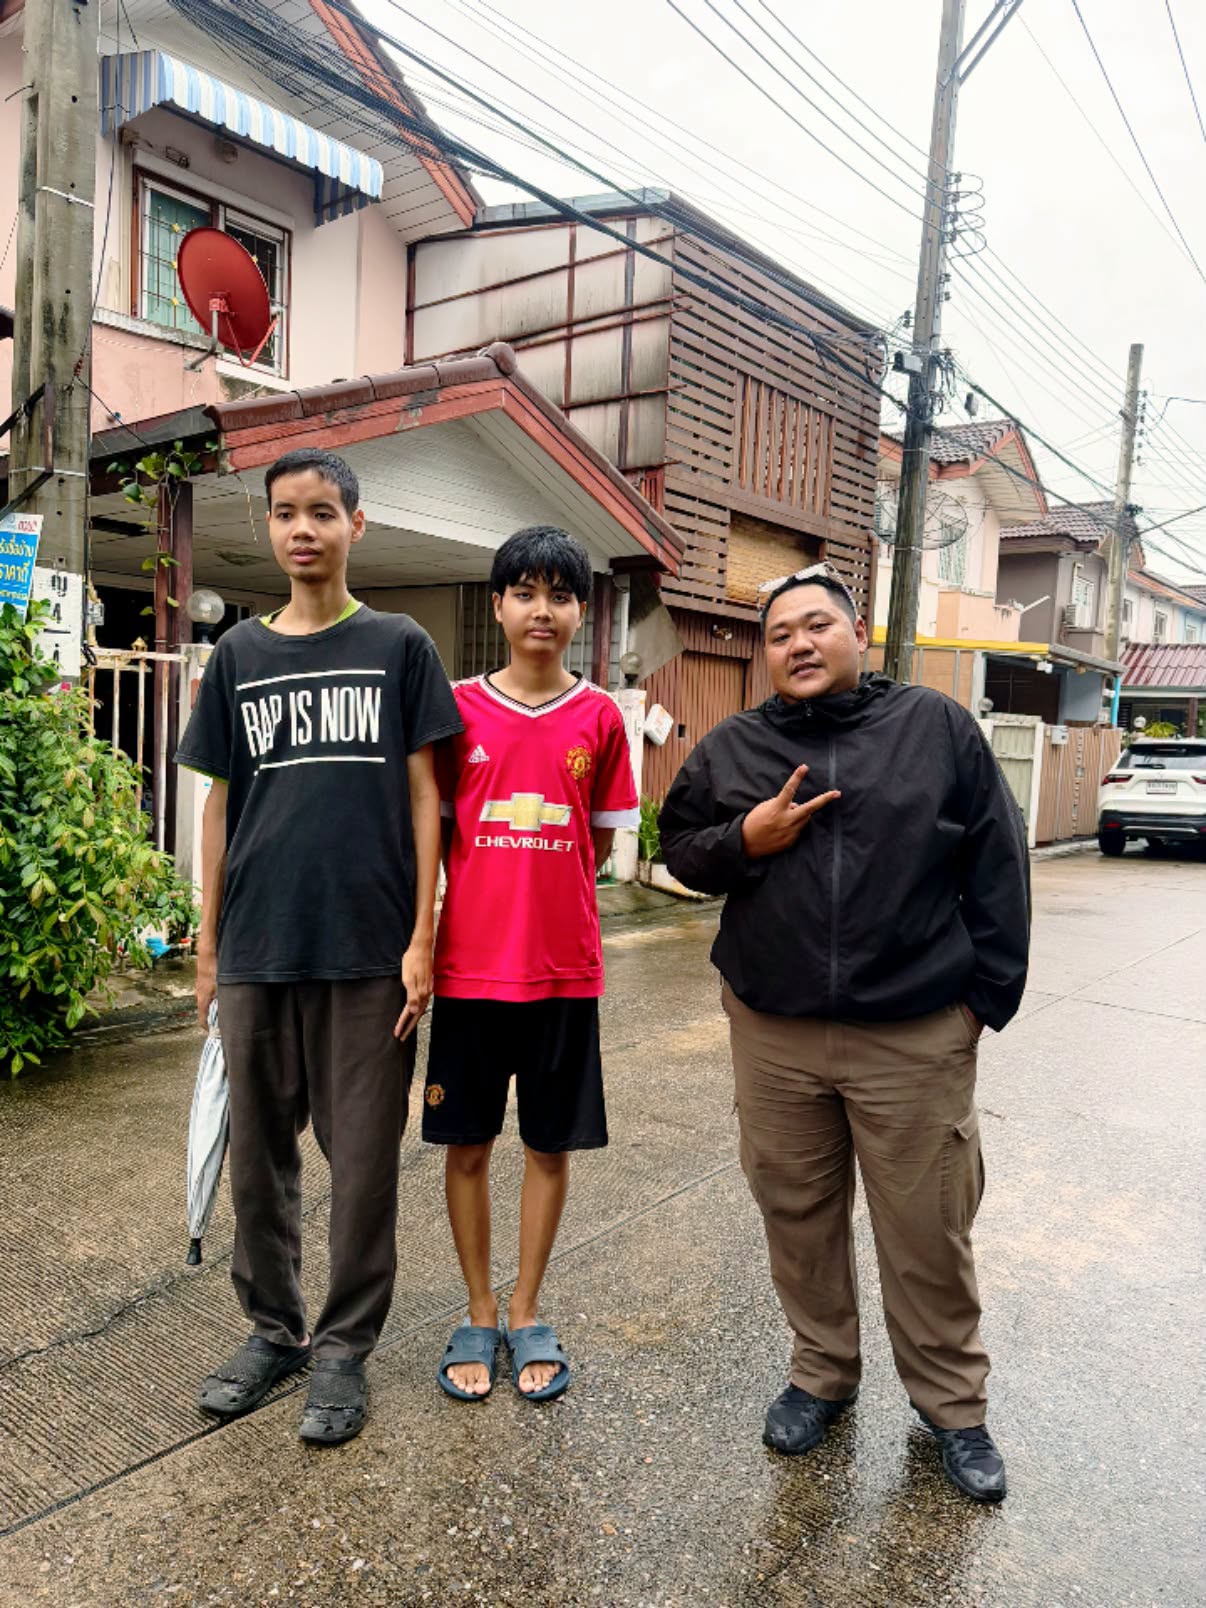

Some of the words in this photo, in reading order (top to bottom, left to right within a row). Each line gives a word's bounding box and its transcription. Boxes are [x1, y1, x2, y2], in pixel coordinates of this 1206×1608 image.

[241, 694, 282, 758] RAP
[289, 690, 312, 747] IS
[320, 686, 381, 743] NOW
[475, 835, 574, 852] CHEVROLET
